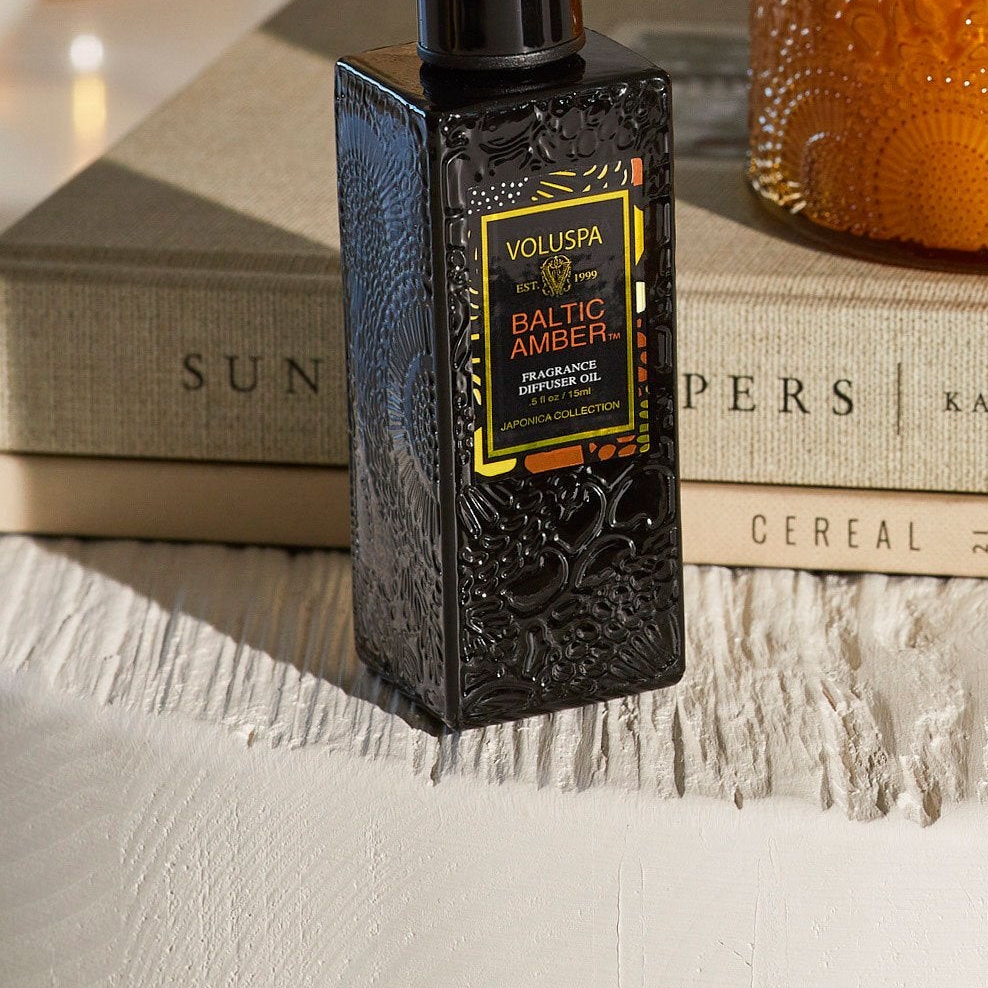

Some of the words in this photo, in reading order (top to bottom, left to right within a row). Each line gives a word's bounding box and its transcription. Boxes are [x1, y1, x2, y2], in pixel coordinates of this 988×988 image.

[506, 225, 603, 261] VOLUSPA
[515, 280, 540, 294] EST.
[573, 270, 598, 283] 1999
[511, 297, 606, 335] BALTIC
[183, 352, 324, 395] SUN
[682, 371, 856, 419] PERS
[518, 377, 577, 396] DIFFUSER
[579, 372, 602, 383] OIL
[521, 359, 598, 383] FRAGRANCE
[539, 395, 546, 404] fl
[547, 394, 560, 403] oz
[568, 387, 592, 399] 15ml
[500, 413, 553, 431] JAPONICA
[553, 400, 621, 421] COLLECTION
[752, 513, 921, 552] CEREAL
